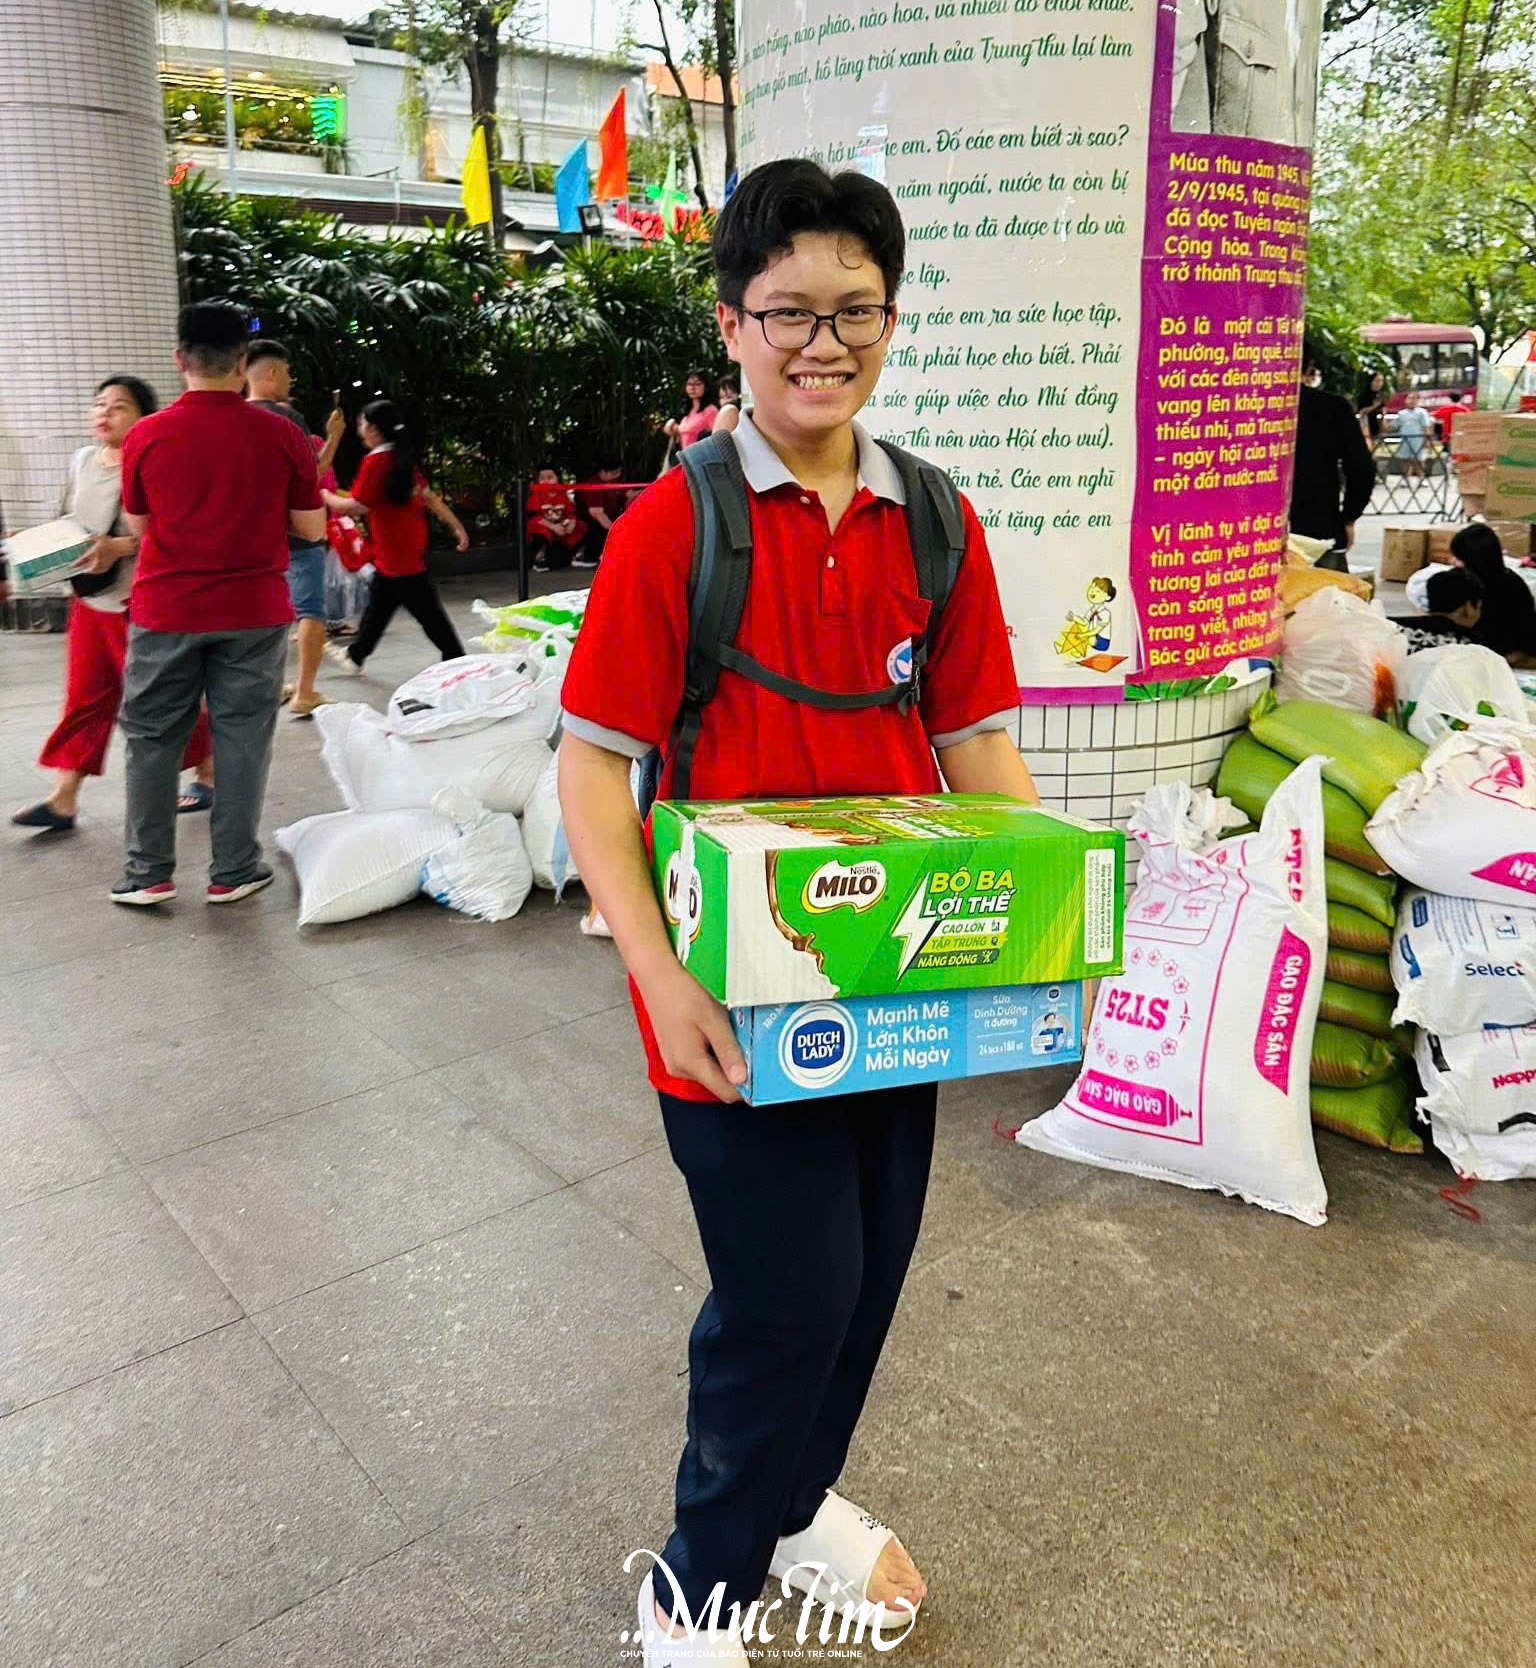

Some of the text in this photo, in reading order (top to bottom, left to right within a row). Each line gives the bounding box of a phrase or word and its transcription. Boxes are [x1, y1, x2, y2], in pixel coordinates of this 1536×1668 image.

[900, 34, 1134, 67] xanh của Trung làm
[902, 123, 1129, 153] em. Đố các em biết sao?
[1169, 151, 1275, 179] Mùa thu năm
[897, 171, 1104, 206] năm ngoái, nước ta còn
[1168, 180, 1248, 205] 2/9/1945,
[908, 212, 1126, 241] nước ta đã được do và
[1166, 208, 1191, 227] đã
[1197, 209, 1228, 232] đọc
[1233, 210, 1271, 235] Tuyên
[1164, 235, 1253, 258] Cộng hòa.
[920, 262, 950, 291] lập.
[1162, 261, 1189, 281] trở
[1195, 263, 1241, 282] thành
[1245, 266, 1277, 287] Trung
[927, 302, 1122, 329] các em sức học tập.
[1160, 316, 1252, 338] Đó là một
[923, 342, 1121, 373] phải học cho biết. Phải
[1159, 343, 1229, 367] phường,
[1232, 343, 1260, 364] làng
[1158, 369, 1248, 388] với các đèn
[915, 384, 1119, 415] giúp việc cho Nhi đồng
[1158, 398, 1201, 416] vang
[1208, 395, 1230, 413] lên
[1235, 388, 1264, 411] khắp
[935, 427, 1071, 451] nên vào Hội cho
[1156, 417, 1233, 440] thiếu nhi,
[1172, 448, 1215, 468] ngày
[1219, 445, 1241, 466] hội
[1245, 444, 1265, 460] của
[977, 467, 1115, 495] trẻ. Các em nghĩ
[1154, 466, 1255, 496] một đất nước
[1008, 509, 1112, 536] tặng các em
[1151, 520, 1213, 545] Vị lãnh
[1150, 548, 1185, 568] tình
[1191, 545, 1222, 564] cảm
[1226, 542, 1249, 564] yêu
[1149, 567, 1245, 597] tương của
[1148, 593, 1224, 617] còn sống
[1148, 622, 1195, 642] trang
[1150, 638, 1237, 667] Bác gửi các
[815, 875, 878, 899] MILO
[929, 865, 1014, 897] BỘ BA
[923, 888, 1017, 921] LỢI THẾ
[942, 921, 985, 934] CAO LỚN
[930, 937, 987, 950] TẬP TRUNG
[918, 953, 978, 967] NĂNG ĐỘNG
[867, 1001, 950, 1026] Mạnh Mẽ
[974, 1009, 996, 1018] Dinh
[997, 1005, 1028, 1016] Dưỡng
[1104, 988, 1170, 1032] ST25
[1262, 954, 1303, 1067] GẠO ĐẶC SẢN
[797, 1030, 841, 1048] DUTCH
[867, 1024, 948, 1048] Lớn Khôn
[802, 1044, 836, 1061] LADY
[865, 1048, 950, 1072] Mỗi Ngày
[979, 1045, 987, 1055] 24
[1104, 1084, 1131, 1108] ĐẶC
[1133, 1091, 1162, 1116] GẠO
